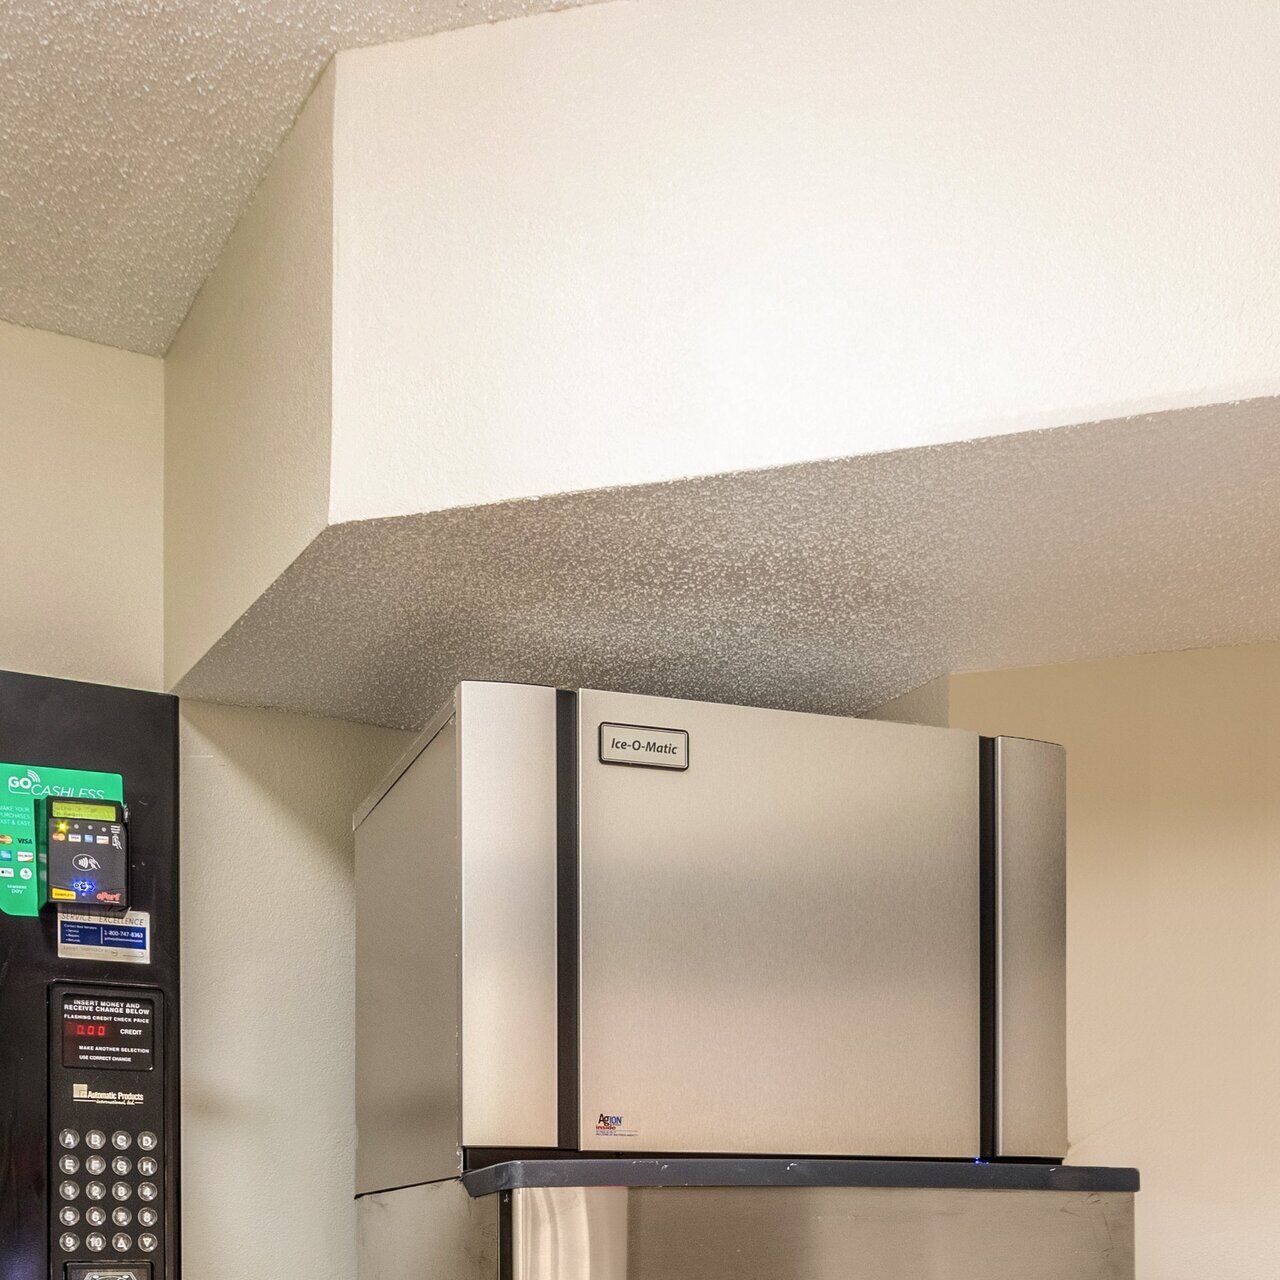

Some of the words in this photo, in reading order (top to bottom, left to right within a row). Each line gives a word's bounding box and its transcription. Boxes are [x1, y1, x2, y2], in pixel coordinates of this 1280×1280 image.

[610, 738, 678, 755] Ice-O-Matic
[8, 776, 32, 789] GO
[73, 999, 98, 1007] INSERT
[63, 1004, 94, 1012] RECEIVE
[95, 1006, 125, 1014] CHANGE
[120, 1028, 143, 1036] CREDIT
[87, 1090, 117, 1100] Automatic
[118, 1091, 144, 1101] Products
[64, 1133, 74, 1145] A
[91, 1134, 101, 1145] B
[116, 1135, 127, 1146] C
[142, 1136, 152, 1147] D
[65, 1159, 74, 1170] E
[91, 1160, 100, 1171] F
[116, 1161, 127, 1172] G
[142, 1160, 152, 1172] H
[92, 1185, 100, 1196] 2
[92, 1211, 100, 1222] 6
[143, 1212, 151, 1223] 8
[65, 1237, 74, 1248] 9
[90, 1237, 102, 1248] 10
